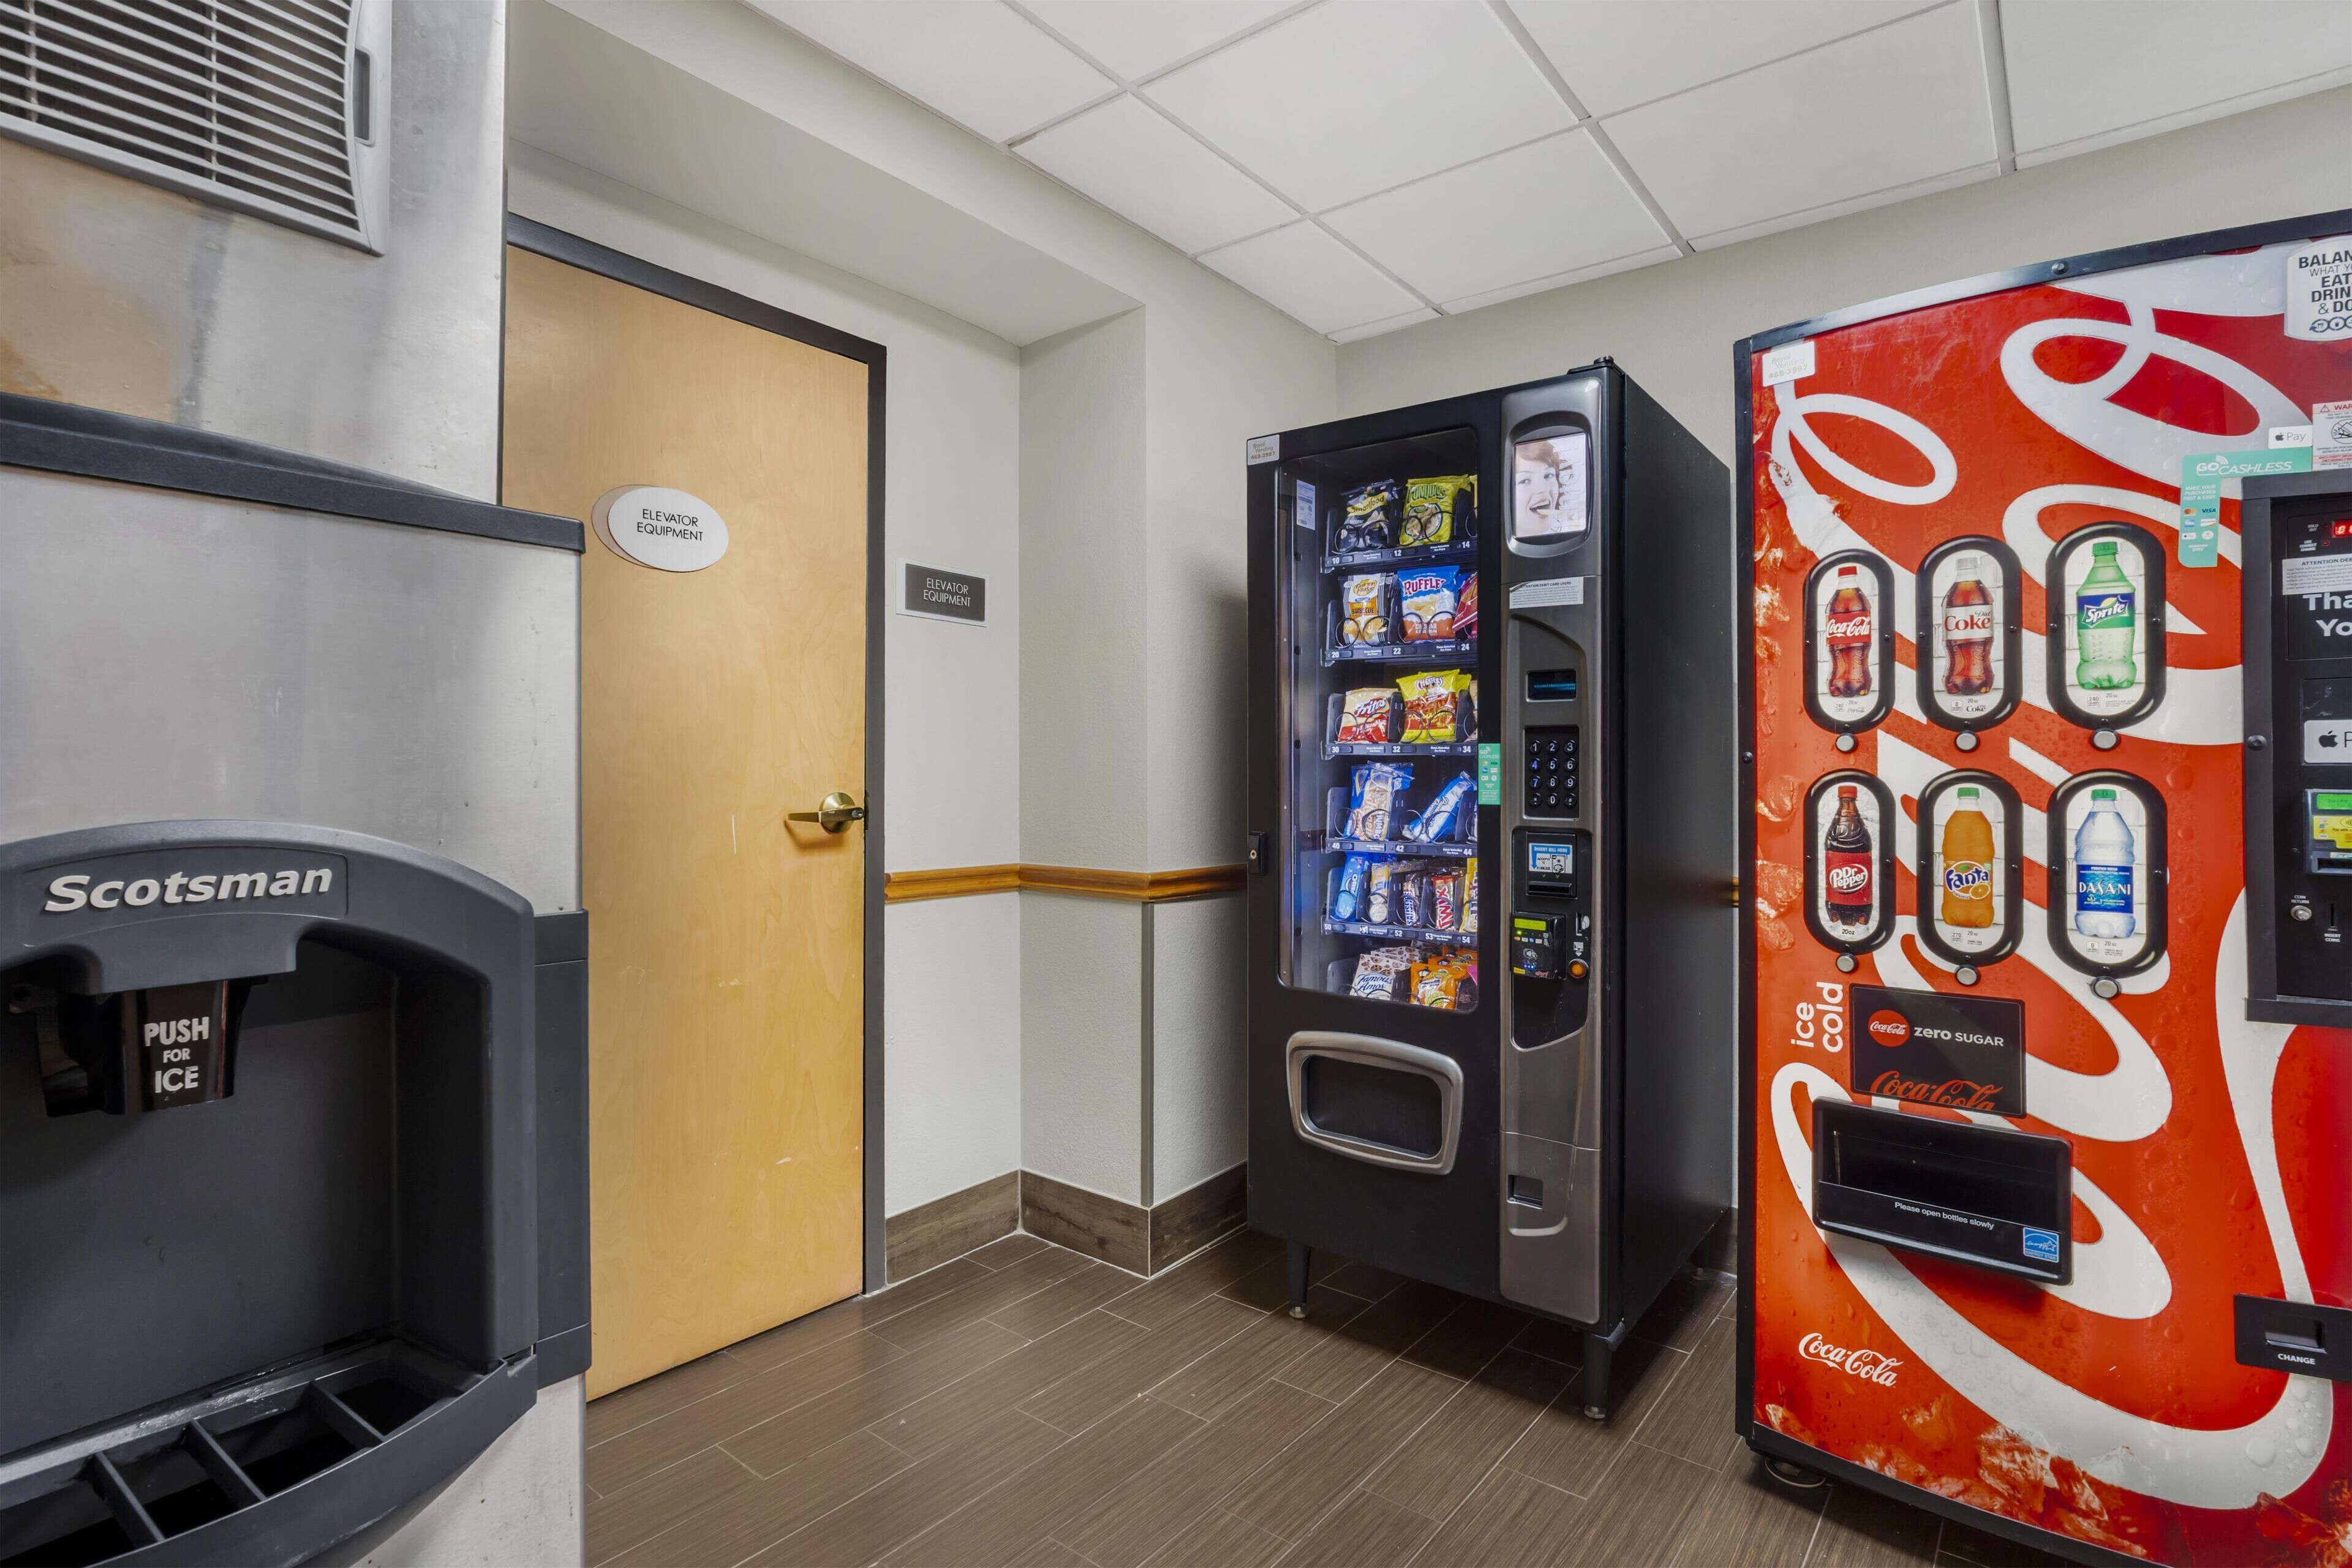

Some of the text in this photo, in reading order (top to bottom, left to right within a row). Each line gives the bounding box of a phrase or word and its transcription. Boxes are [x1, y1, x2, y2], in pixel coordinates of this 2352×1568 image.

[2310, 263, 2352, 277] WHAT Y
[2321, 273, 2352, 288] EAT
[2312, 286, 2351, 303] DRIN
[2318, 303, 2329, 315] &
[2286, 432, 2306, 442] Pay
[2196, 461, 2293, 475] GO CASHLESS
[1351, 495, 1385, 513] Smartfood
[643, 509, 698, 527] ELEVATOR
[637, 522, 703, 541] EQUIPMENT
[927, 578, 968, 595] ELEVATOR
[923, 589, 971, 607] EQUIPMENT
[2086, 602, 2125, 624] Sprite
[1826, 616, 1871, 638] Coca-Cola
[1944, 614, 1991, 631] Coke
[2316, 619, 2352, 636] Yo
[1355, 698, 1387, 714] Fritos
[1533, 743, 1537, 752] 1
[1567, 743, 1573, 752] 3
[1532, 761, 1573, 769] 4 5 6
[1533, 778, 1574, 787] 7 8 9
[1550, 796, 1555, 804] 0
[1833, 869, 1866, 889] Pepper
[1842, 867, 1857, 877] Dr
[1946, 865, 1989, 892] Fanta
[43, 868, 333, 912] Scotsman
[2079, 880, 2131, 897] DASANI
[1357, 973, 1392, 984] Famous
[1358, 981, 1385, 992] Amos
[1791, 1001, 1814, 1048] ice
[1816, 981, 1843, 1053] cold
[144, 1016, 209, 1047] PUSH
[1870, 1020, 2005, 1047] Coca-Cola zero SUGAR
[163, 1048, 190, 1063] FOR
[155, 1065, 199, 1092] ICE
[1869, 1070, 2003, 1110] Coca-Cola
[1894, 1201, 1994, 1231] Please open bottles slowly
[2025, 1250, 2045, 1258] ENERGY
[1798, 1332, 1904, 1387] Coca-Cola
[2277, 1353, 2316, 1365] CHANGE
